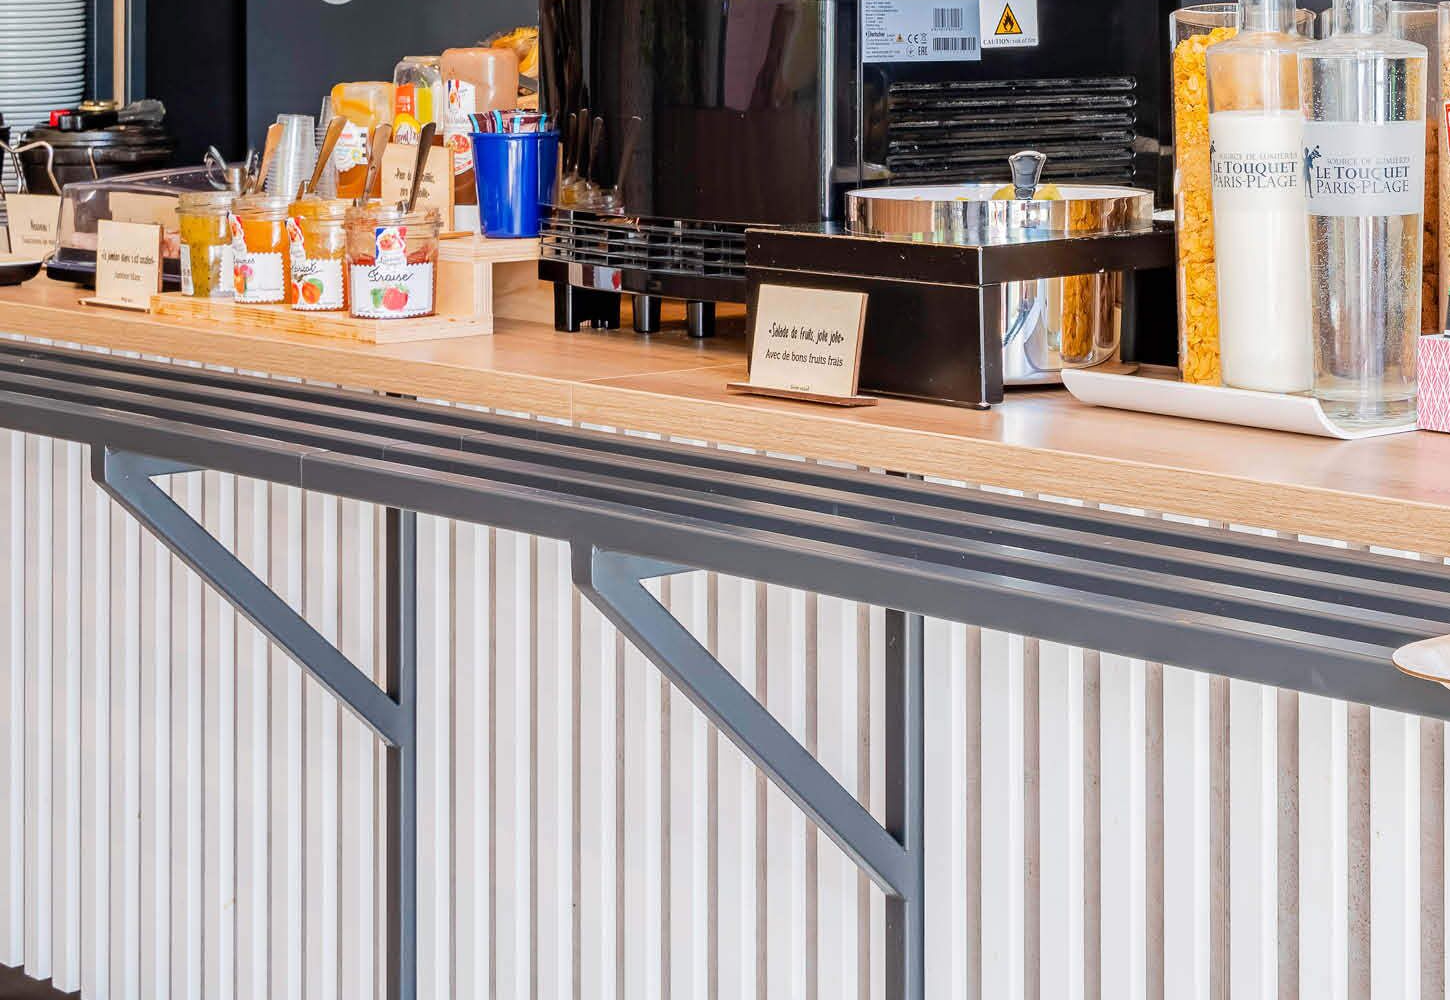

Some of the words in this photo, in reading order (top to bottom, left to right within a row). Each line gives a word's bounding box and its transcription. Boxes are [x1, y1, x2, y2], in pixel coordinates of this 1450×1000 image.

[1225, 160, 1298, 177] TOUQUET
[1316, 165, 1331, 179] LE
[1213, 174, 1297, 188] PARIS-PLAGE
[1316, 179, 1409, 194] PARIS-PLAGE
[367, 266, 413, 282] Fraise
[790, 325, 798, 339] de
[765, 348, 780, 360] Avec
[782, 350, 790, 361] de
[791, 352, 807, 363] bons
[808, 353, 826, 365] fruits
[827, 355, 843, 367] frais
